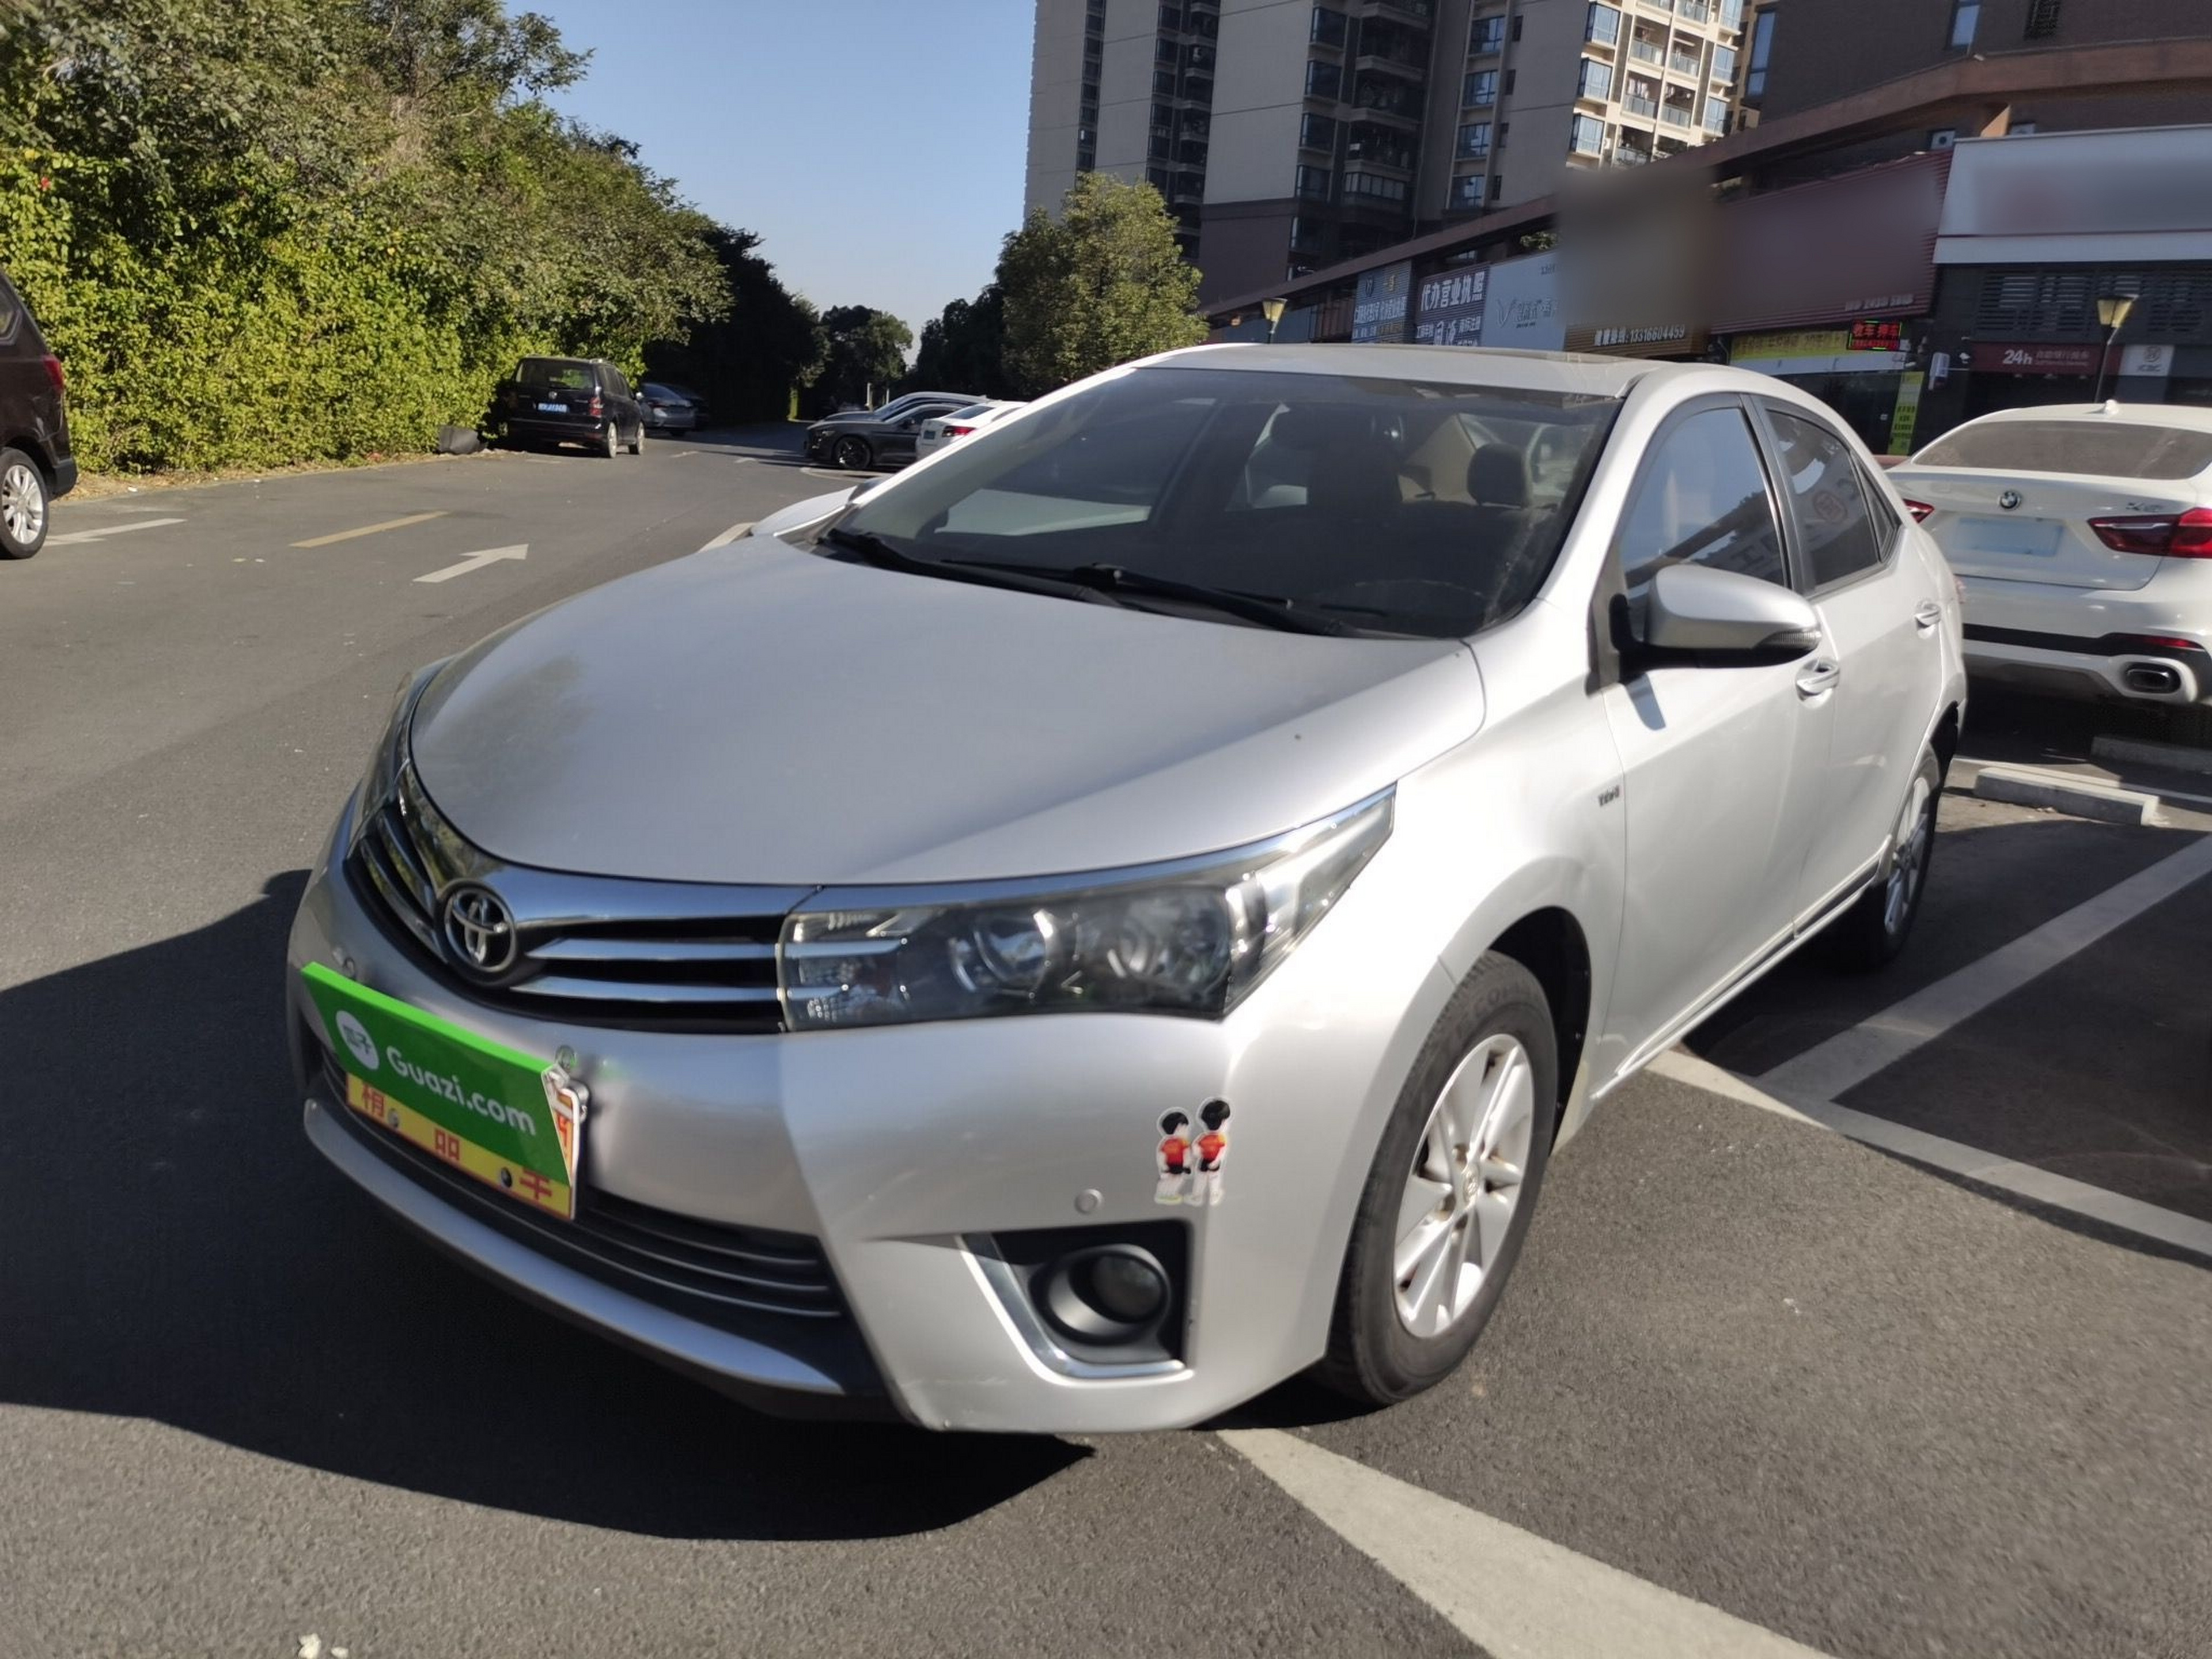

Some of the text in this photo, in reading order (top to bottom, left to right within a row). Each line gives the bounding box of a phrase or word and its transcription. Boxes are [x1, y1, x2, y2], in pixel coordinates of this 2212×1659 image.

[1421, 271, 1485, 312] 代办营业执照
[2002, 349, 2033, 365] 24h
[387, 1046, 536, 1136] Guazi.com
